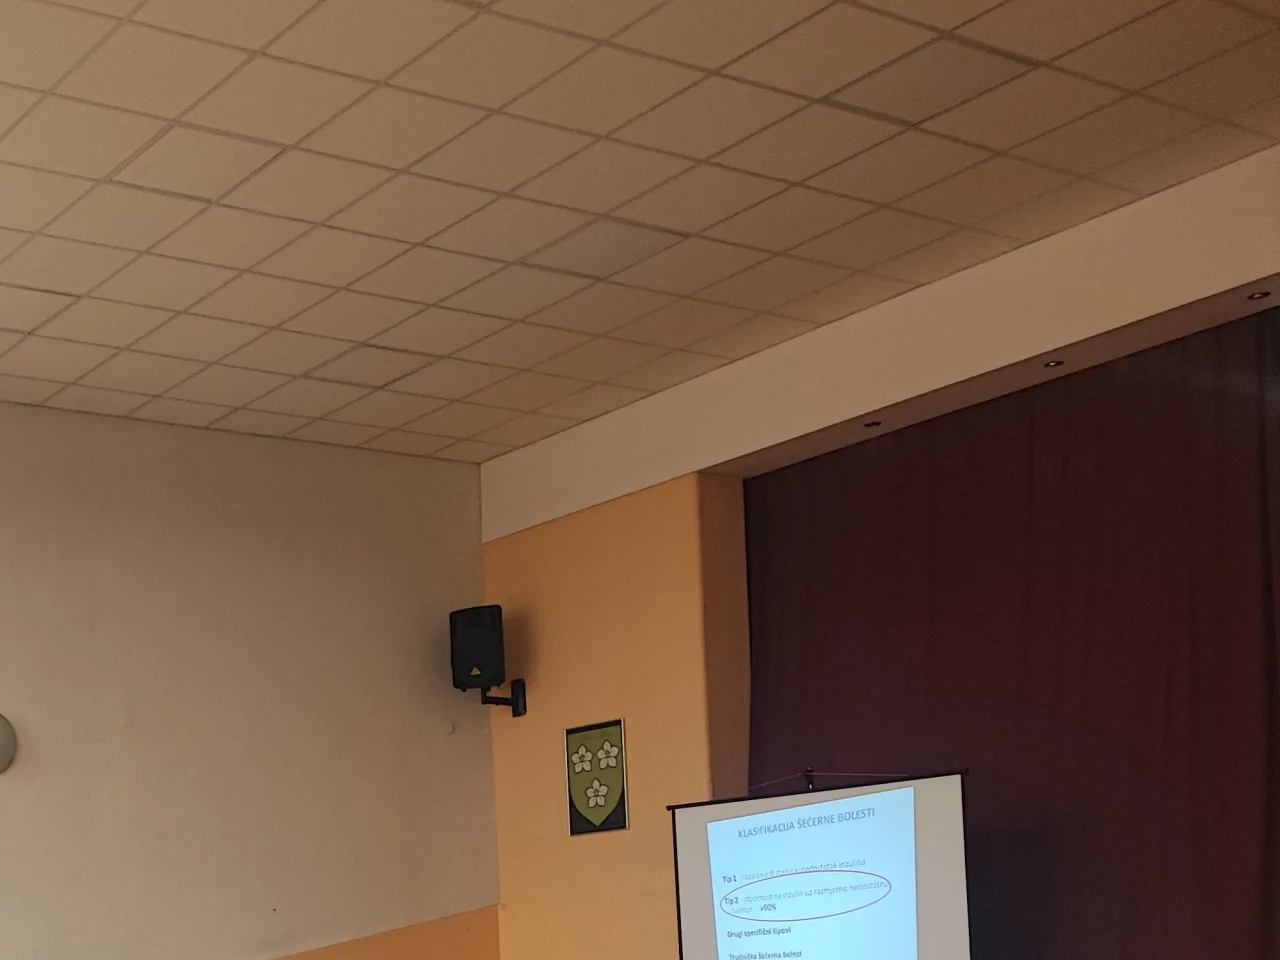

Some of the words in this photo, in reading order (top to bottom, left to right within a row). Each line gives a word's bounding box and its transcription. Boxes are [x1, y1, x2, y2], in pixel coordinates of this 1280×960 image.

[838, 808, 875, 822] BOLESTI
[722, 875, 733, 884] Tip
[724, 897, 734, 906] Tip
[727, 929, 743, 939] Drugi
[782, 949, 802, 958] bolest
